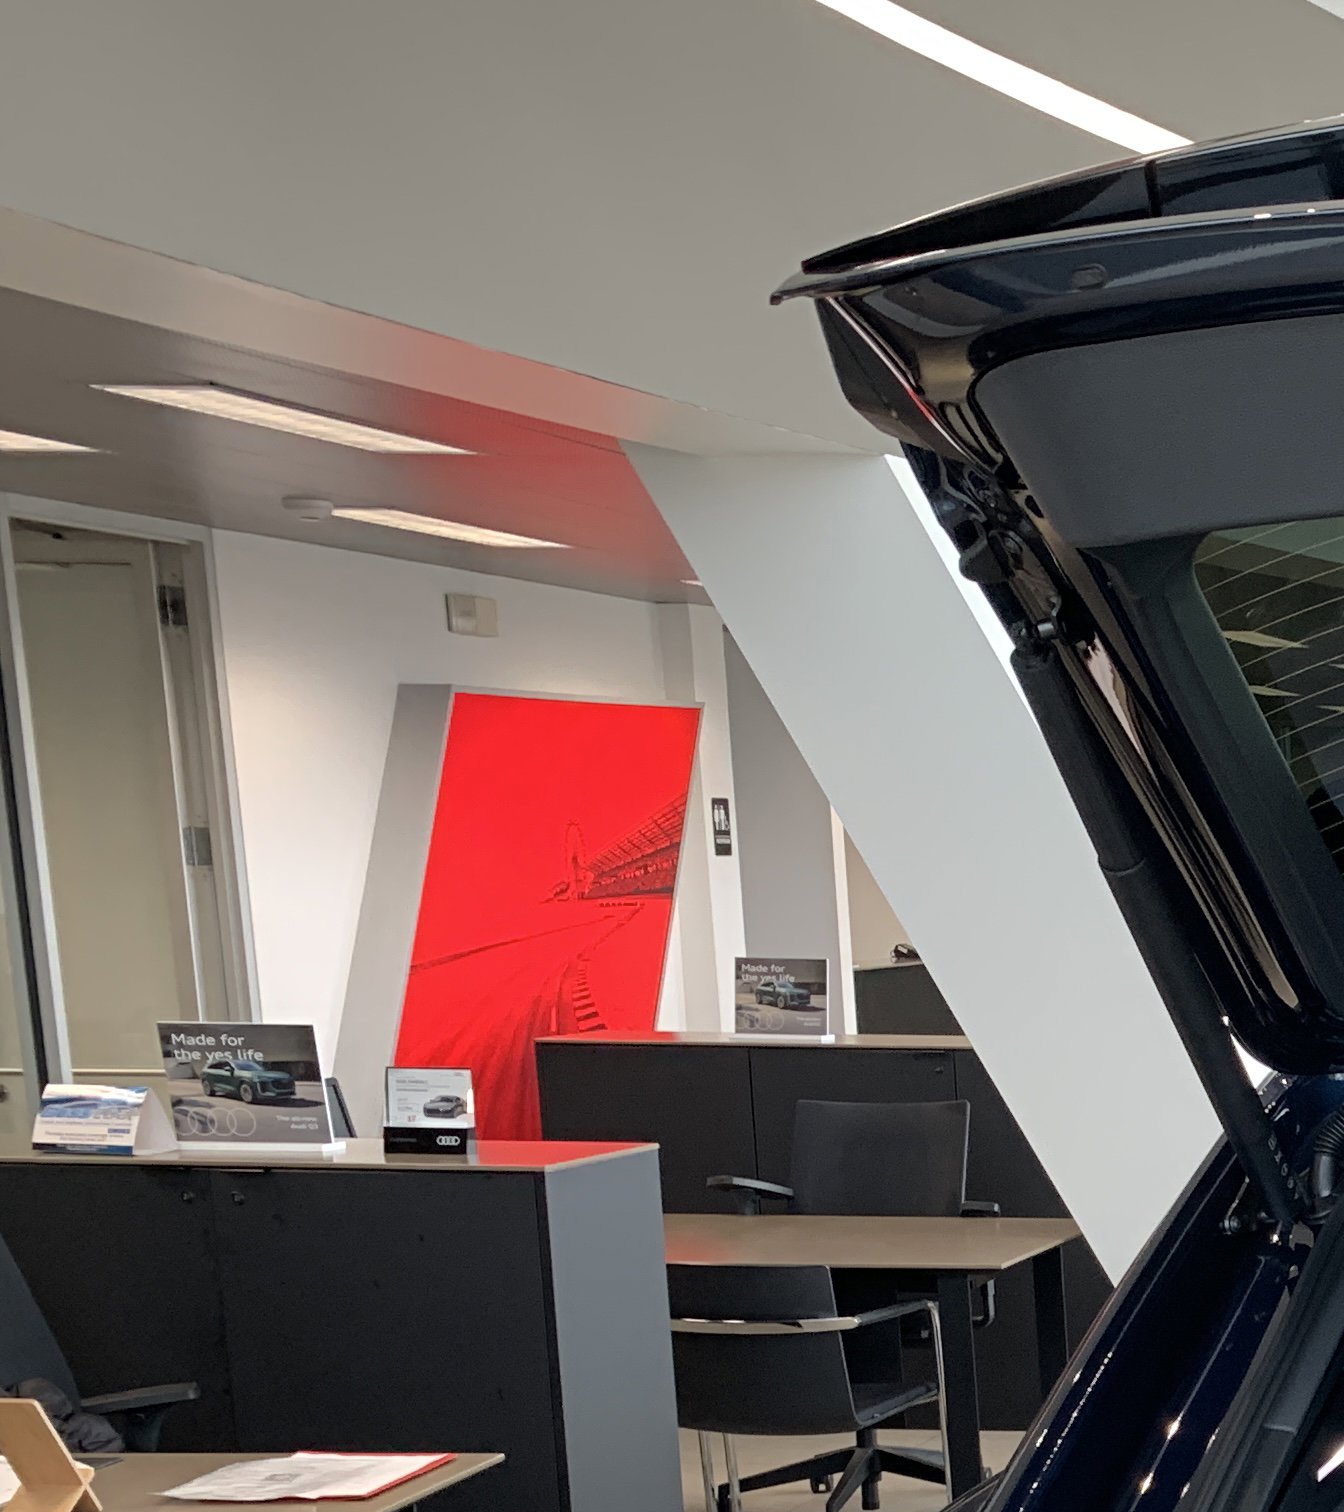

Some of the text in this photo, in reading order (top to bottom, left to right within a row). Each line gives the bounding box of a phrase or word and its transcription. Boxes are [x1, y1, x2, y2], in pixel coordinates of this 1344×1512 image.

[741, 964, 786, 973] Made for
[760, 975, 777, 983] yes
[779, 974, 796, 982] life
[171, 1033, 245, 1046] Made for
[174, 1049, 264, 1063] the yes life
